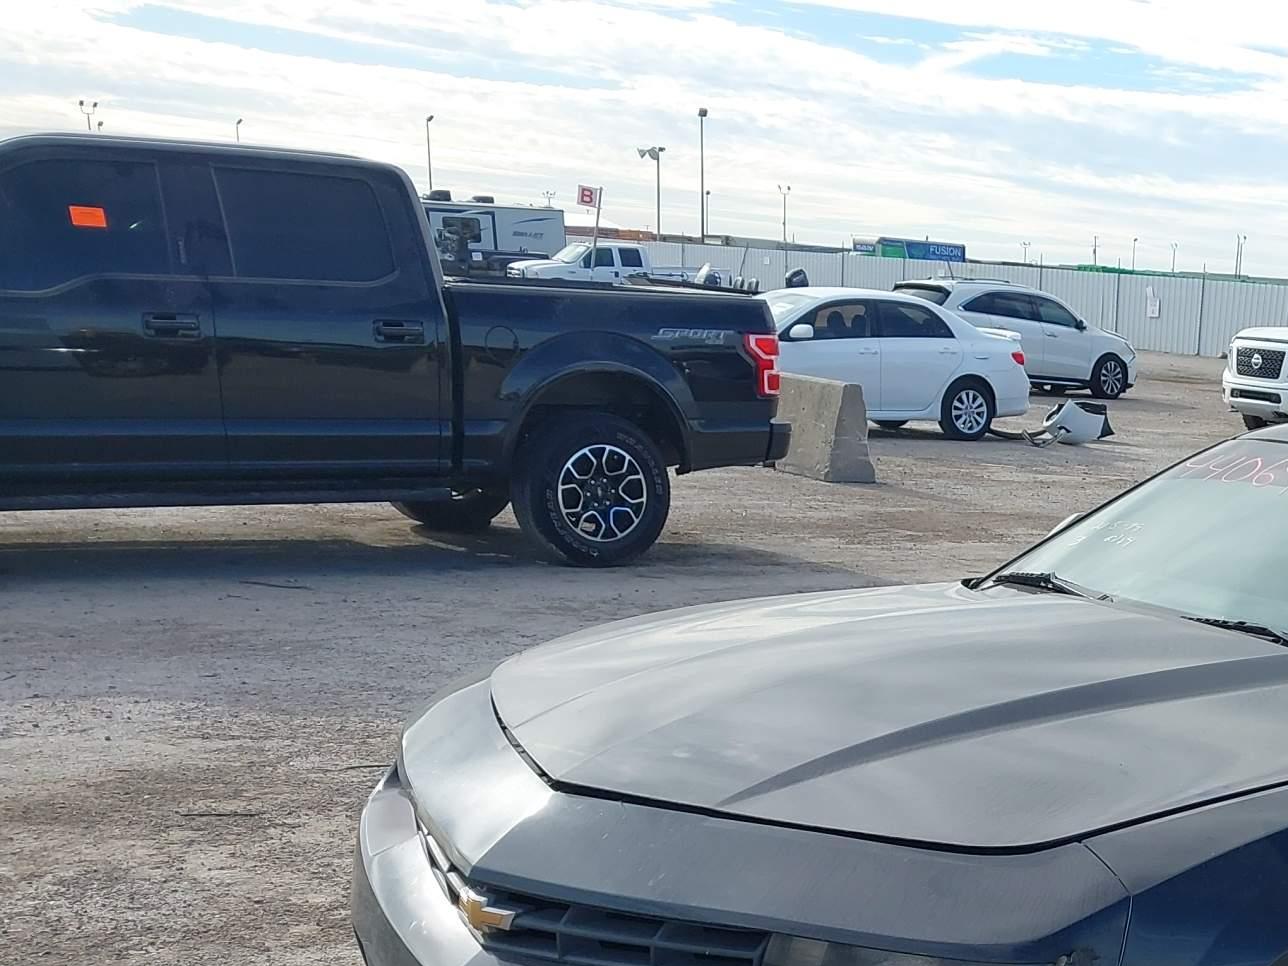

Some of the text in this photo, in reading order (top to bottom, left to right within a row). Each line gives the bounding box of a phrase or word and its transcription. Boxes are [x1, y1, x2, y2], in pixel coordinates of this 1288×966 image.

[581, 187, 593, 204] B
[929, 245, 961, 257] FUSION
[651, 327, 734, 340] SPORT
